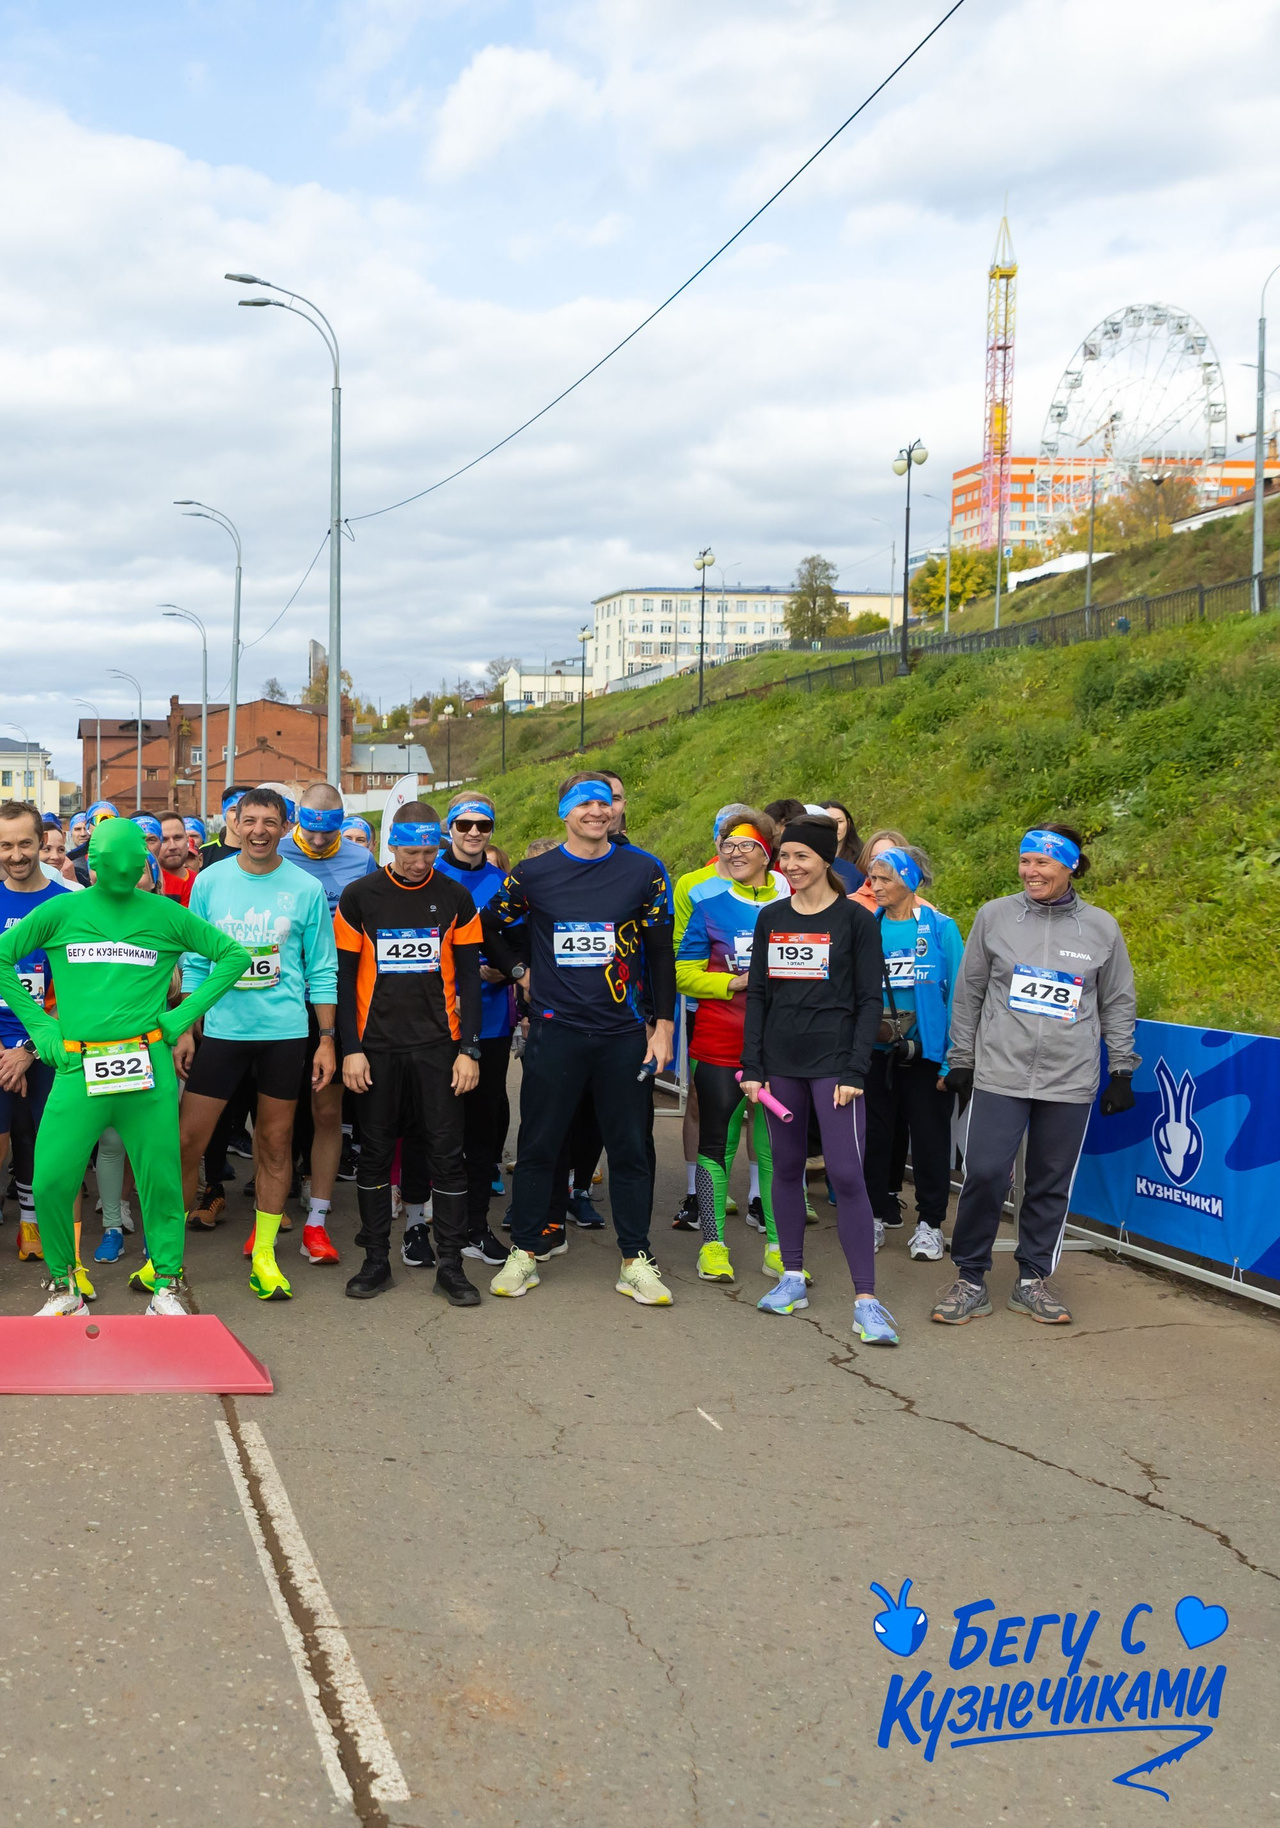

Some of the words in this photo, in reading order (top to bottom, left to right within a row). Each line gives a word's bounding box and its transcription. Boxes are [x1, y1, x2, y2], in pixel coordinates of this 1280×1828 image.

[386, 942, 432, 958] 429
[561, 936, 607, 951] 435
[68, 948, 86, 957] БЕГУ
[88, 948, 94, 957] С
[96, 948, 157, 960] КУЗНЕЧИКАМИ
[777, 946, 814, 961] 193
[250, 960, 271, 975] 16
[1020, 982, 1070, 1003] 478
[95, 1057, 143, 1078] 532
